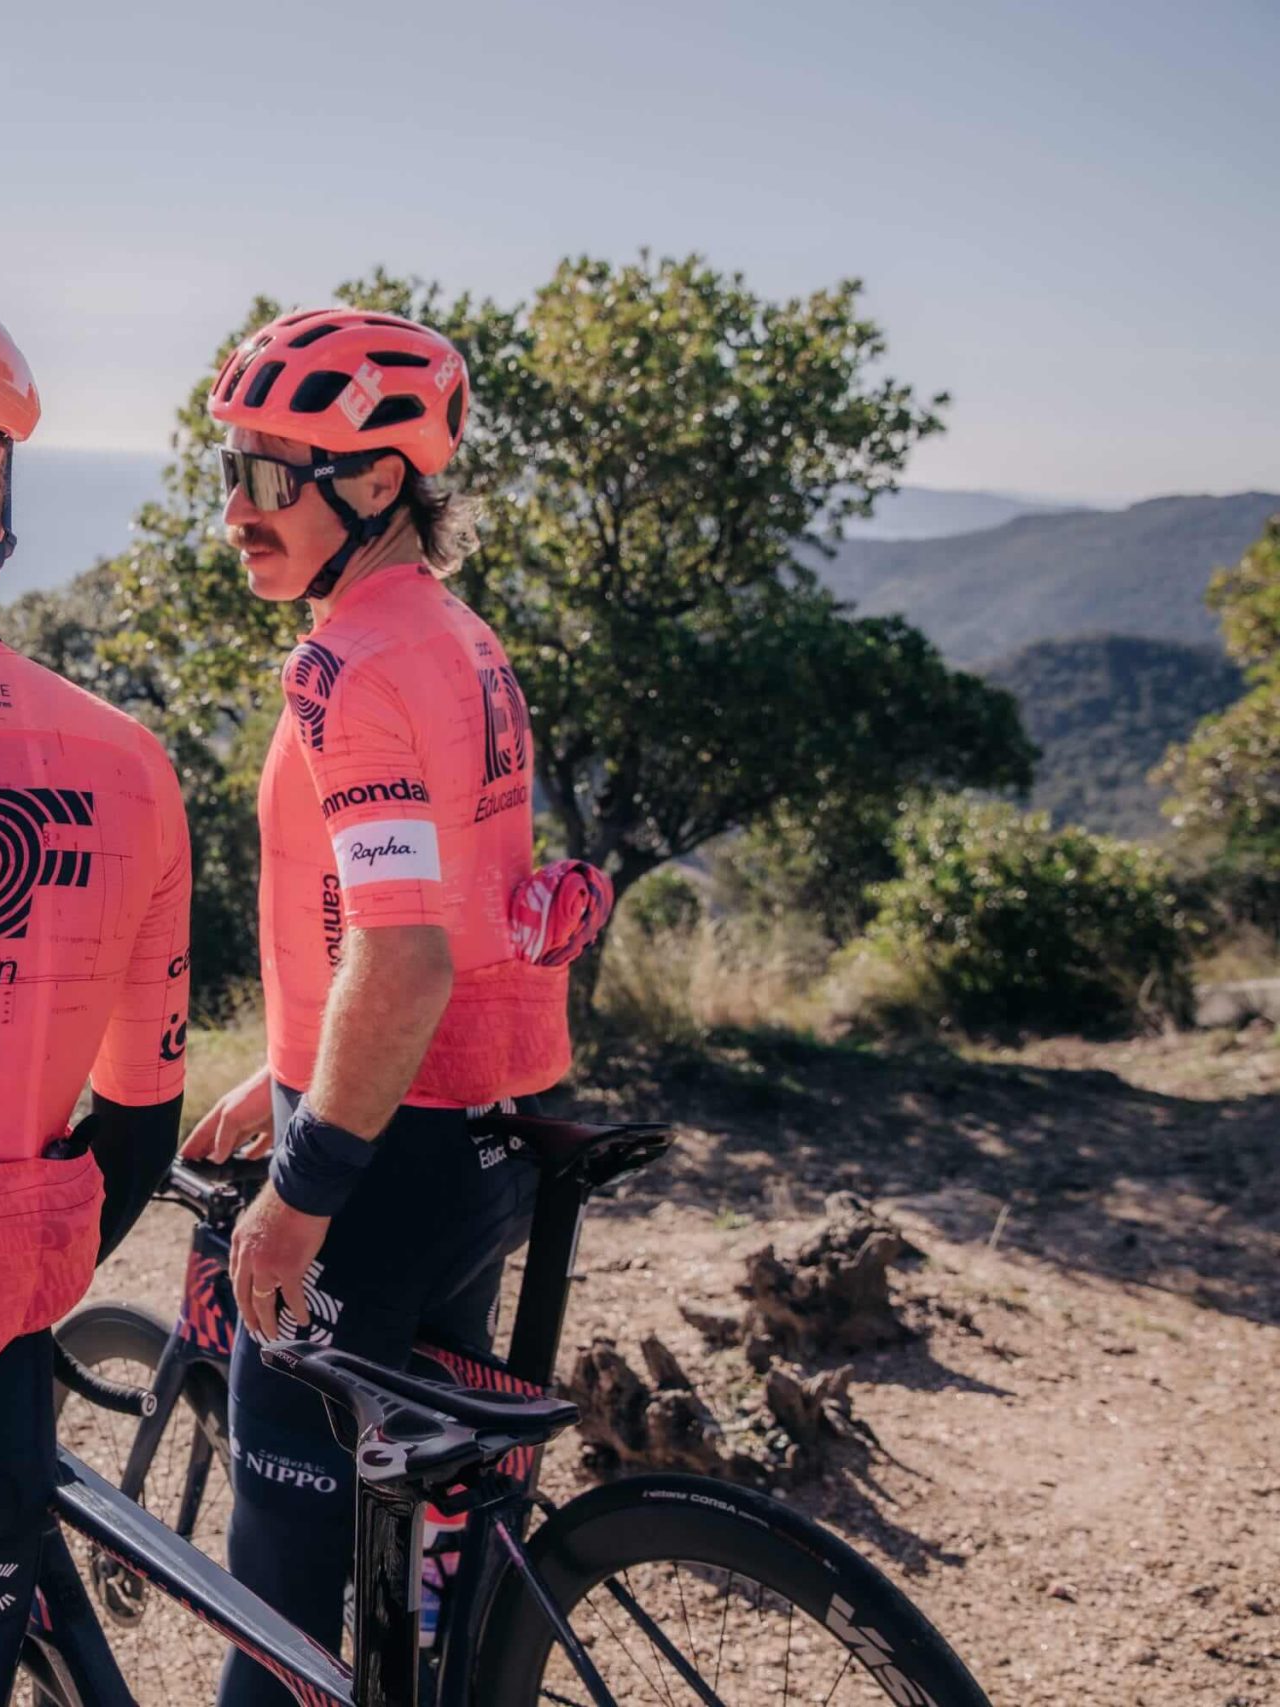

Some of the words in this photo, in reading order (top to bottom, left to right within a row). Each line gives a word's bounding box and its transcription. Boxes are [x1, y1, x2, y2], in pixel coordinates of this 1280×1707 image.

[434, 354, 460, 391] poc
[314, 465, 335, 478] poc
[246, 1451, 338, 1493] NIPPO
[690, 1493, 736, 1514] CORSA
